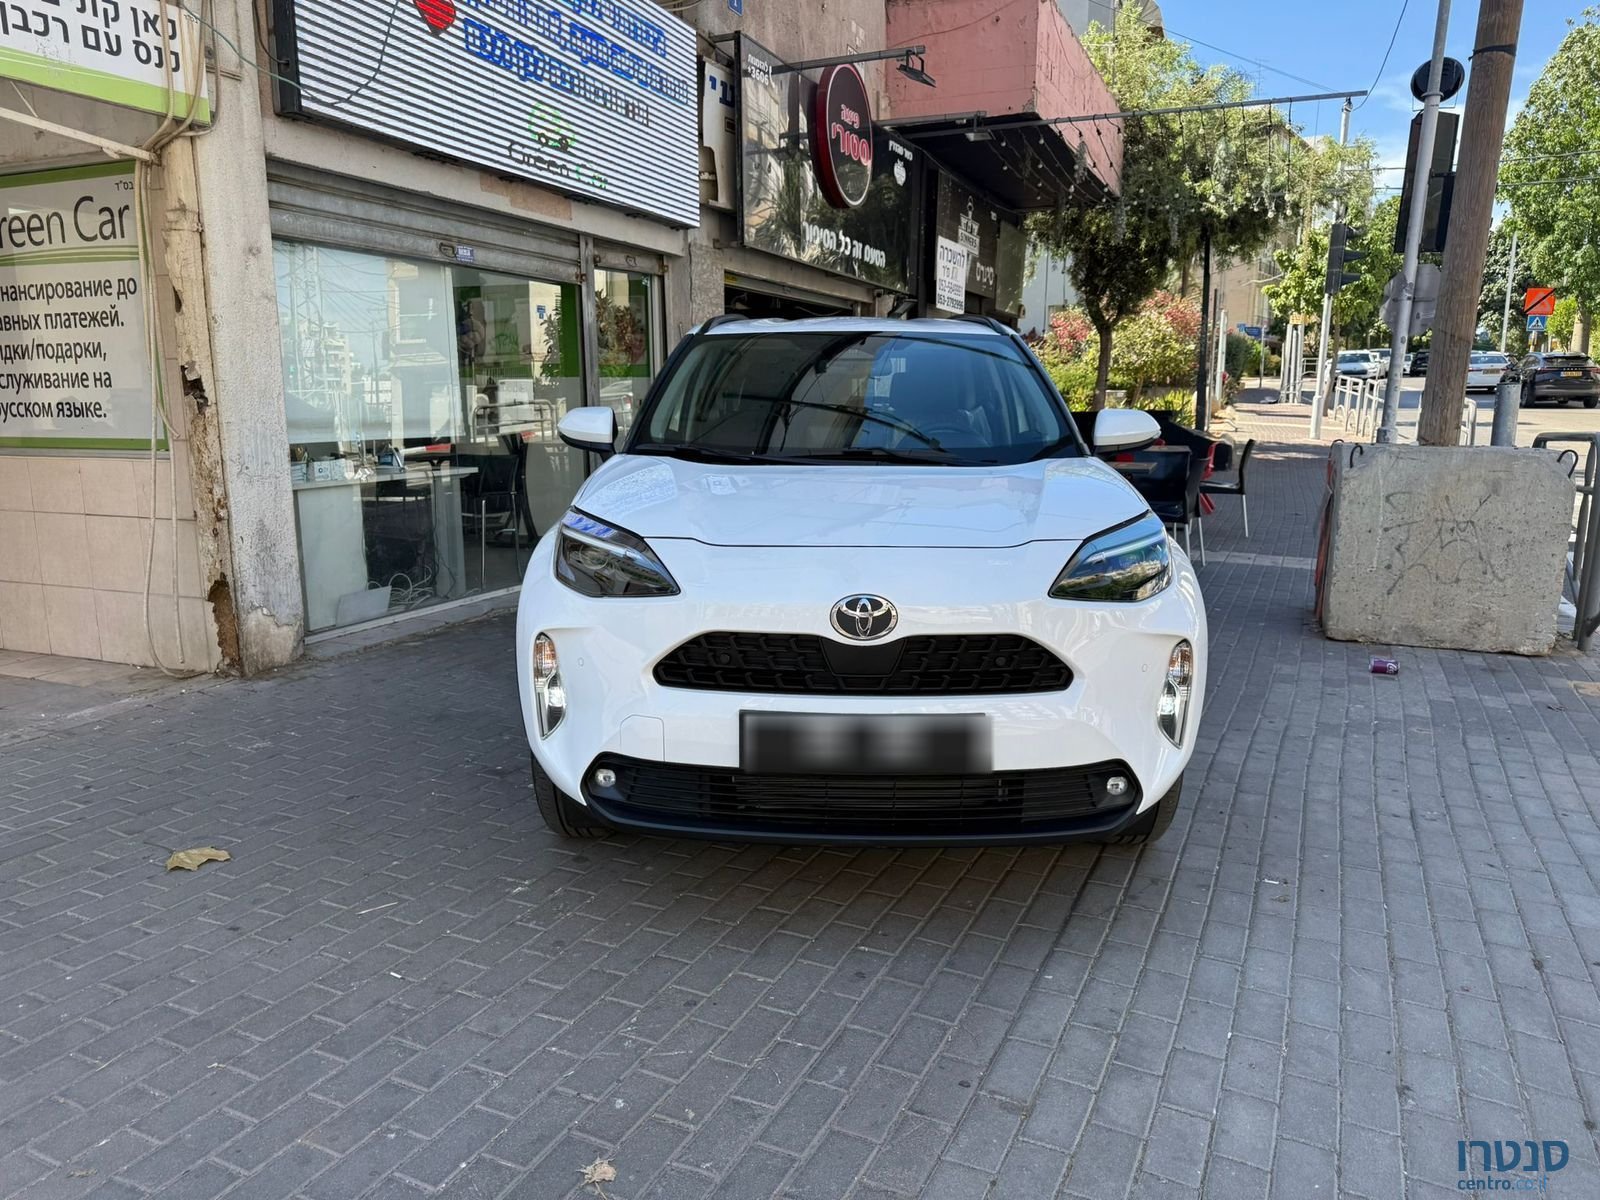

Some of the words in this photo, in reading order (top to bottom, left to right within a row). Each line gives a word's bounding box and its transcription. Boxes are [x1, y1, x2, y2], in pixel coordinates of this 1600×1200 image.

[81, 24, 122, 57] עם
[507, 139, 570, 178] Green
[73, 195, 130, 243] Car
[838, 229, 852, 256] כל
[116, 277, 137, 301] до
[44, 304, 124, 330] платежей.
[93, 370, 112, 389] на
[0, 401, 53, 423] усском
[56, 401, 107, 419] языке.
